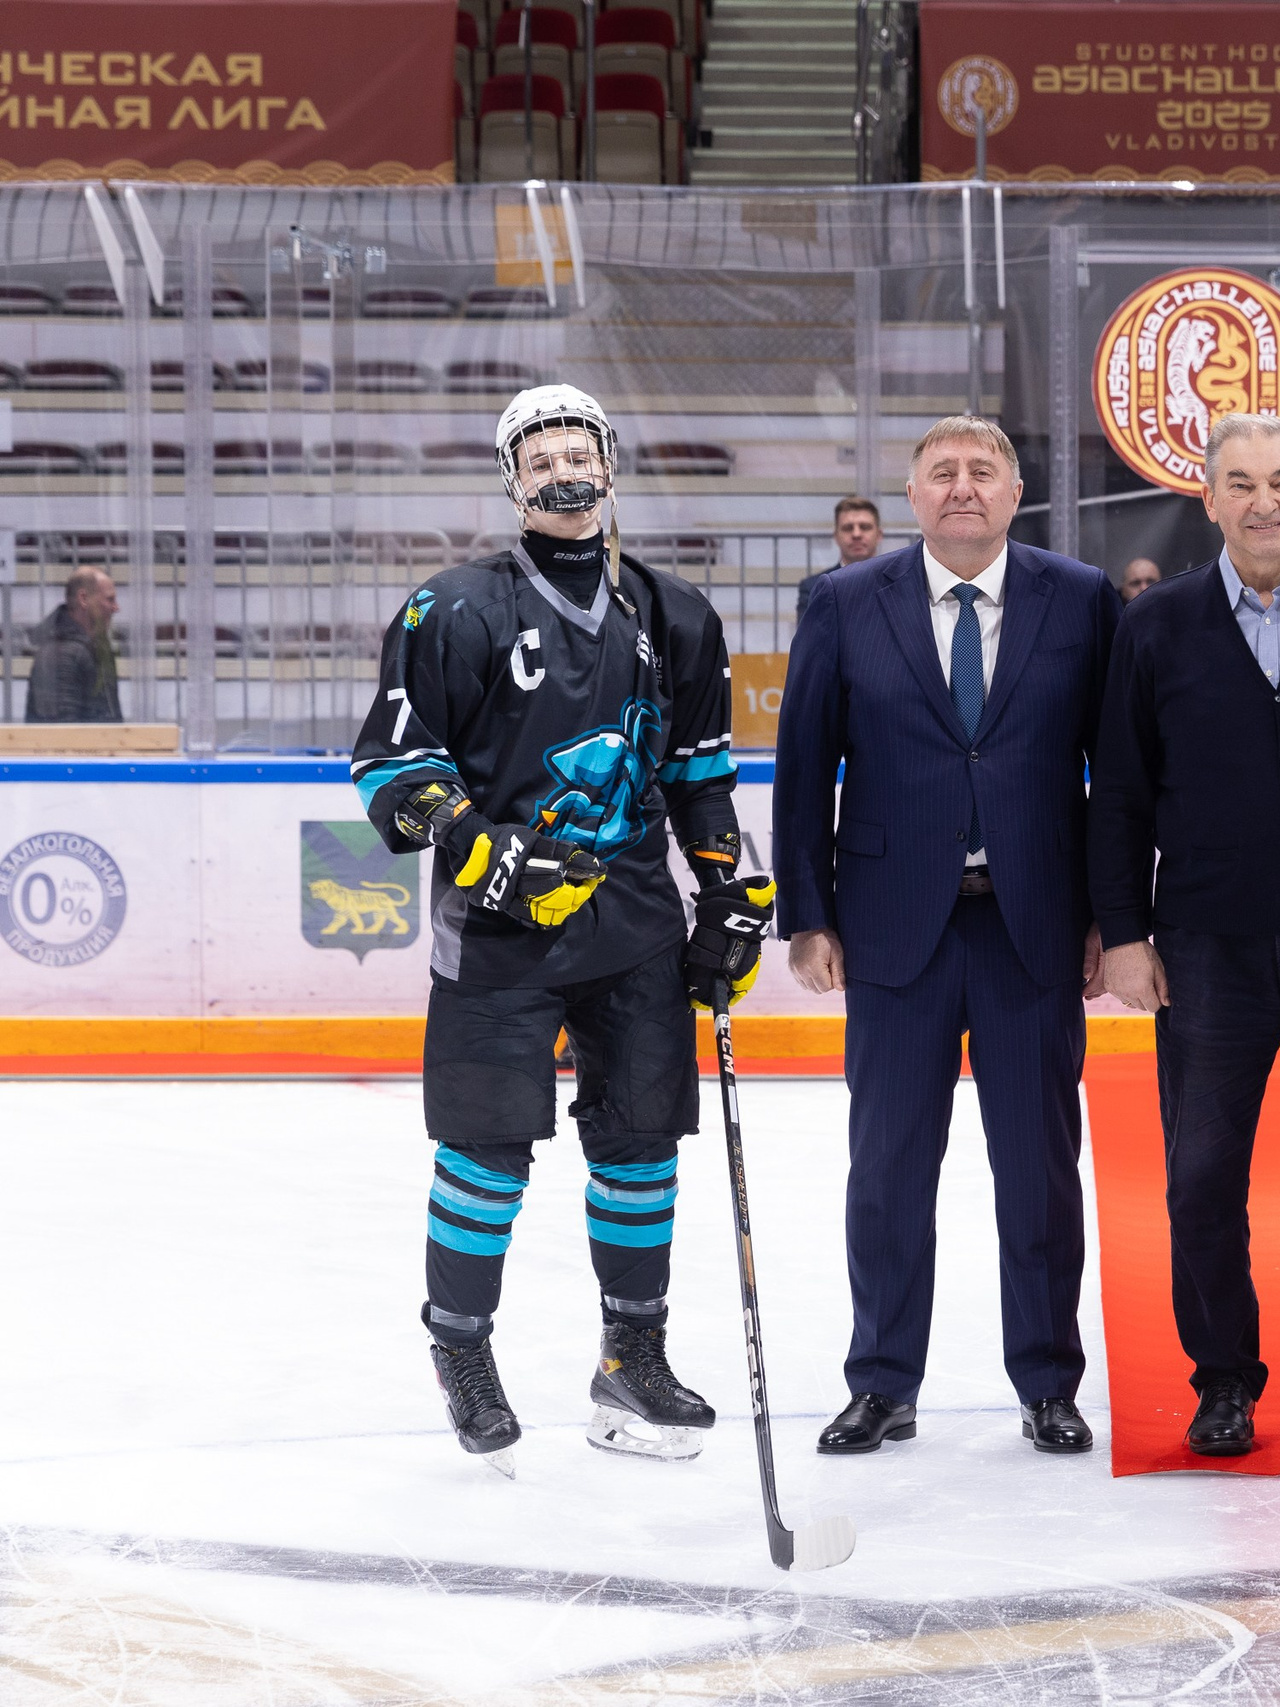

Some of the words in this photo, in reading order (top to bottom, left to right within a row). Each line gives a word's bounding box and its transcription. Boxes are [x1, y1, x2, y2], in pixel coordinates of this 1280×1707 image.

[1076, 43, 1217, 62] STUDENT
[168, 97, 327, 131] ЛИГА
[1157, 101, 1271, 130] 2025
[1106, 334, 1130, 428] RUSSIA
[553, 550, 597, 562] BAUER
[510, 627, 546, 692] C
[387, 688, 414, 746] 7
